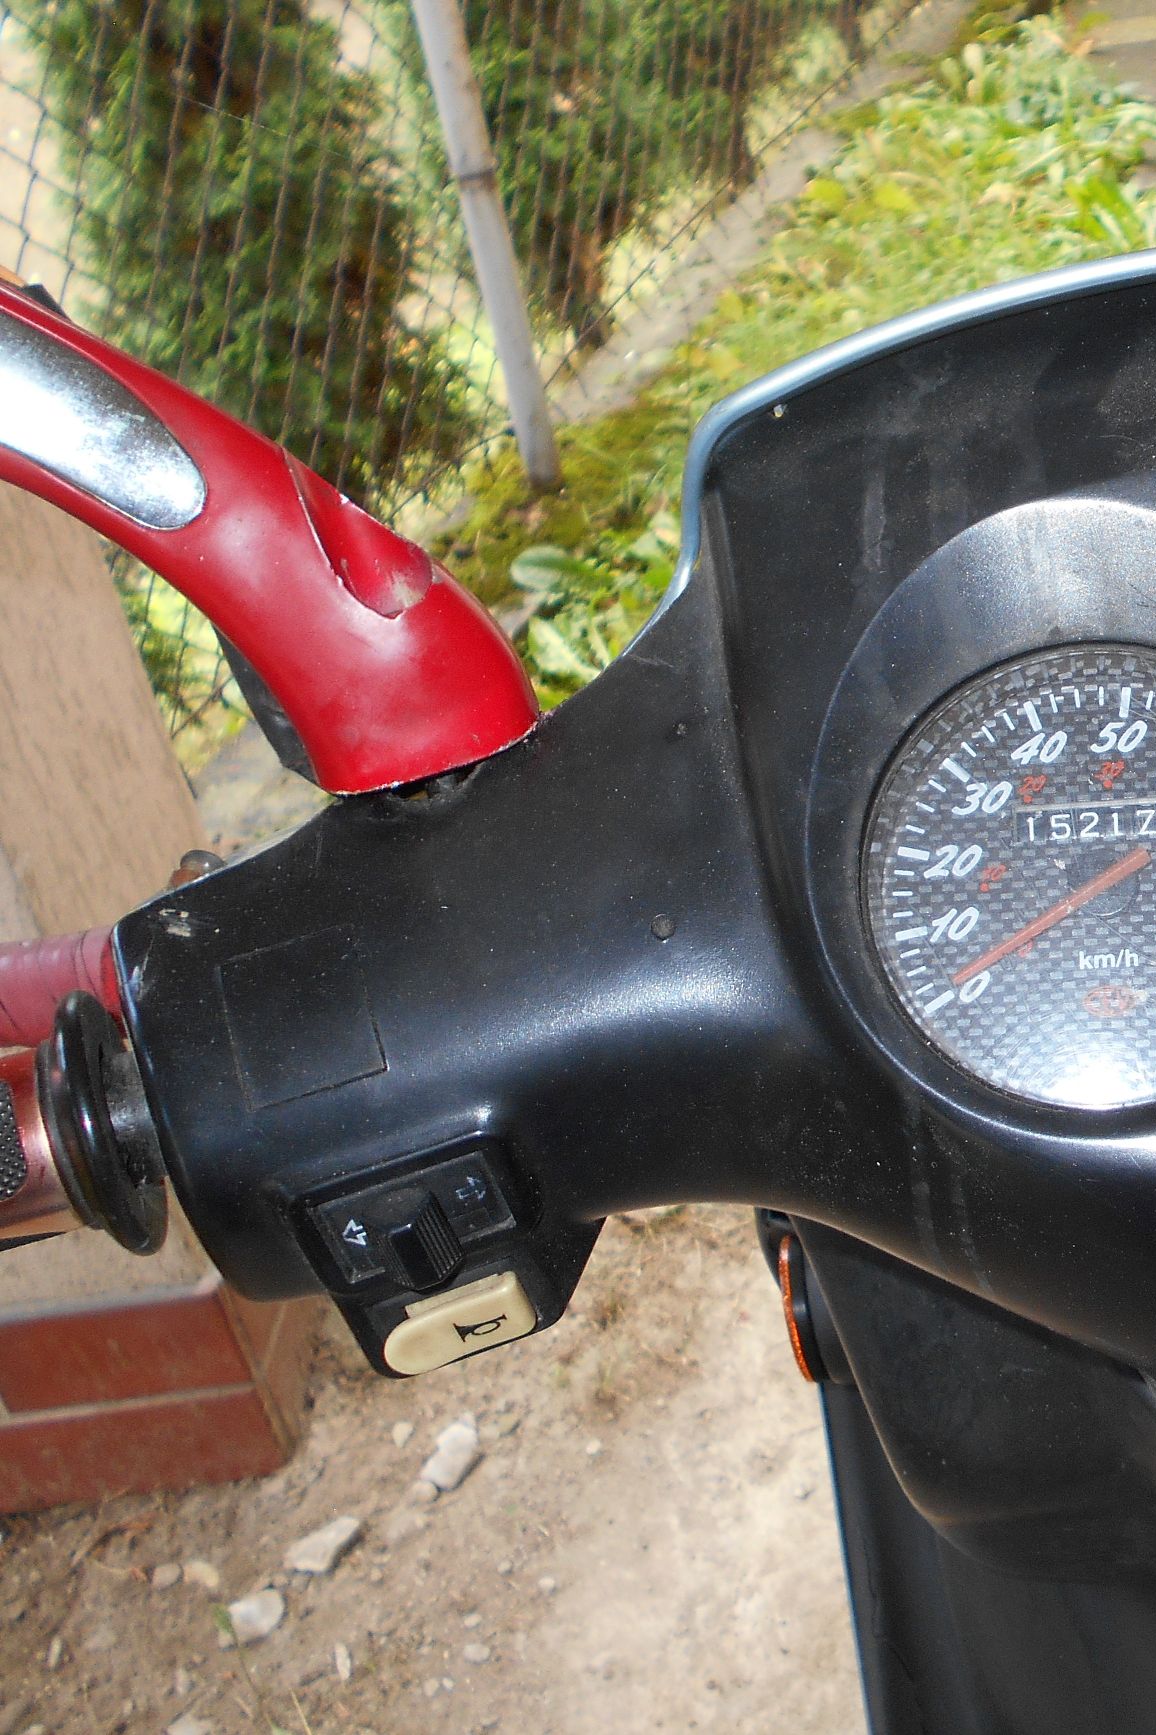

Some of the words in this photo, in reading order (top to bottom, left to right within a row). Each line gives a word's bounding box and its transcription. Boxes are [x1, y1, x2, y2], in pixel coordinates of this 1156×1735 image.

[1011, 730, 1068, 765] 40
[1091, 720, 1149, 754] 50
[952, 780, 1013, 816] 30
[924, 844, 983, 879] 20
[929, 907, 980, 942] 10
[1078, 948, 1139, 970] km/h
[959, 972, 991, 1003] 0
